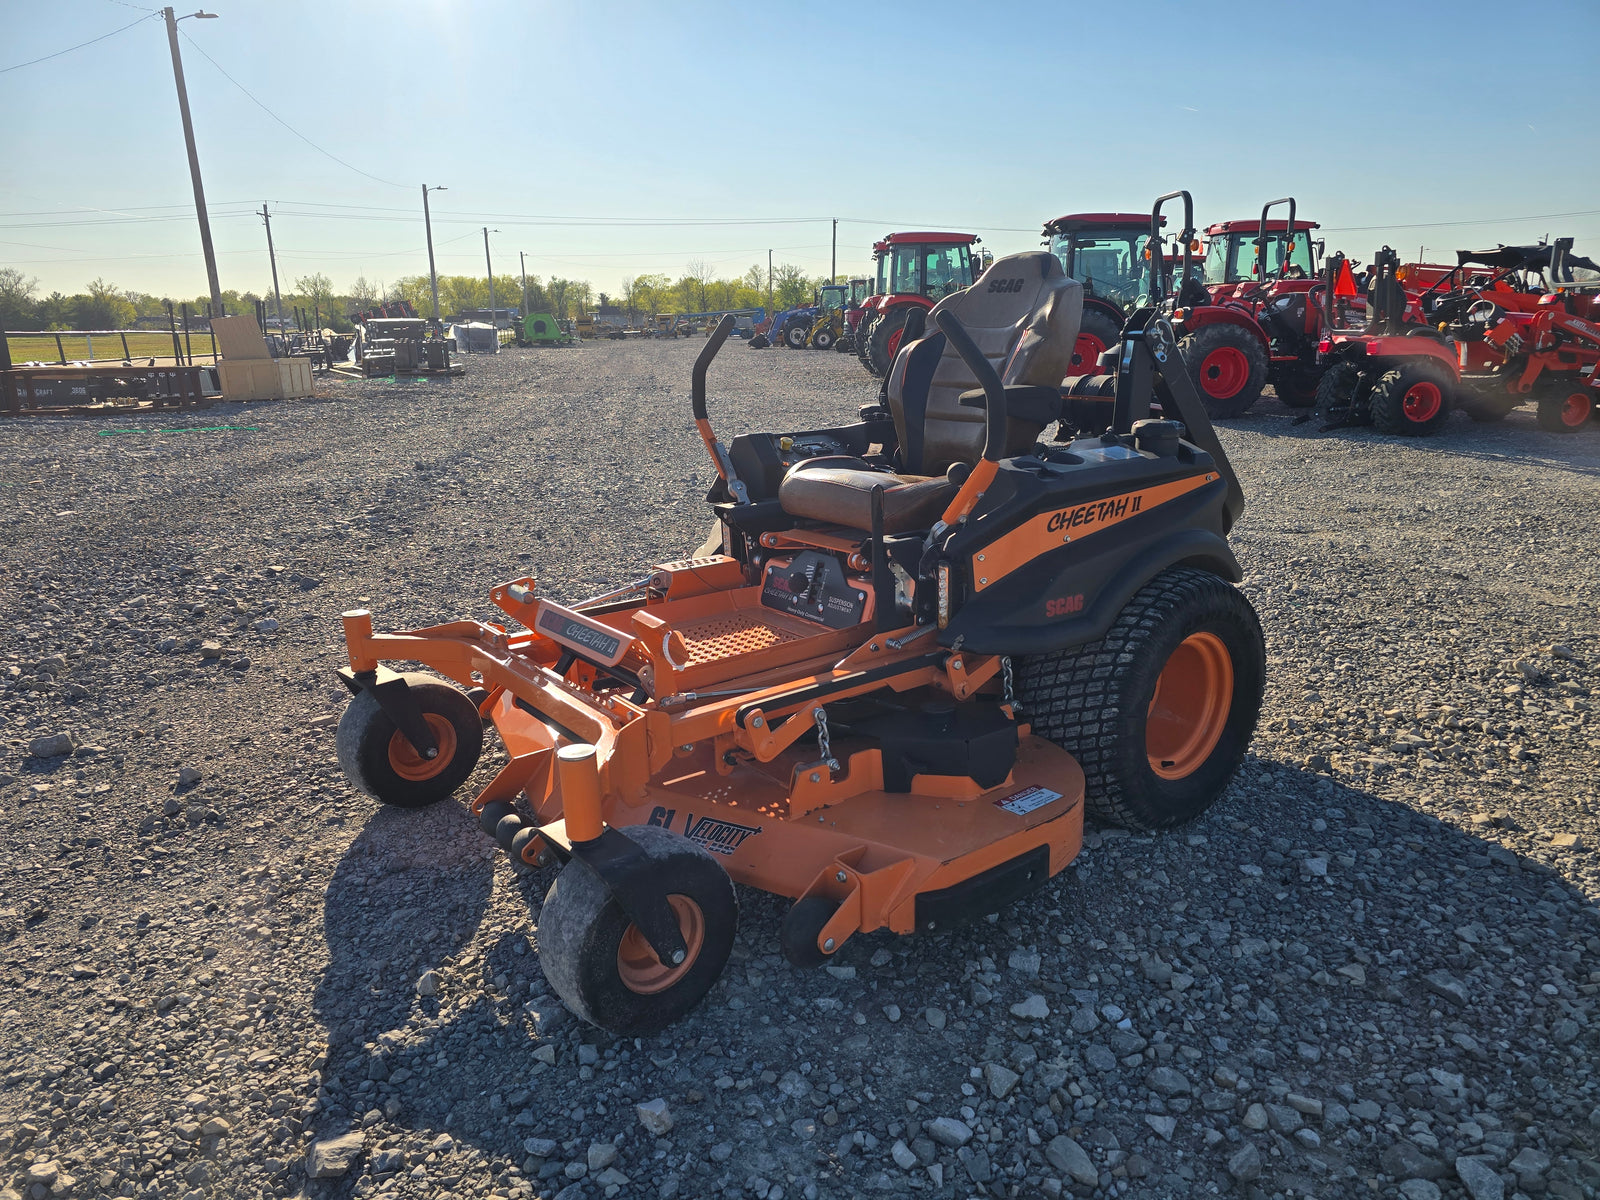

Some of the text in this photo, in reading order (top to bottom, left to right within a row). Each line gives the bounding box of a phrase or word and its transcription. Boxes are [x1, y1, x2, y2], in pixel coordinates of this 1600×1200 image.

[988, 278, 1025, 294] SCAG
[1046, 495, 1143, 533] CHEETAH II
[827, 602, 852, 614] ADJUSTMENT
[828, 595, 854, 609] SUSPENSION
[1045, 593, 1084, 618] SCAG
[566, 623, 608, 651] CHEETAH
[647, 805, 676, 830] 61
